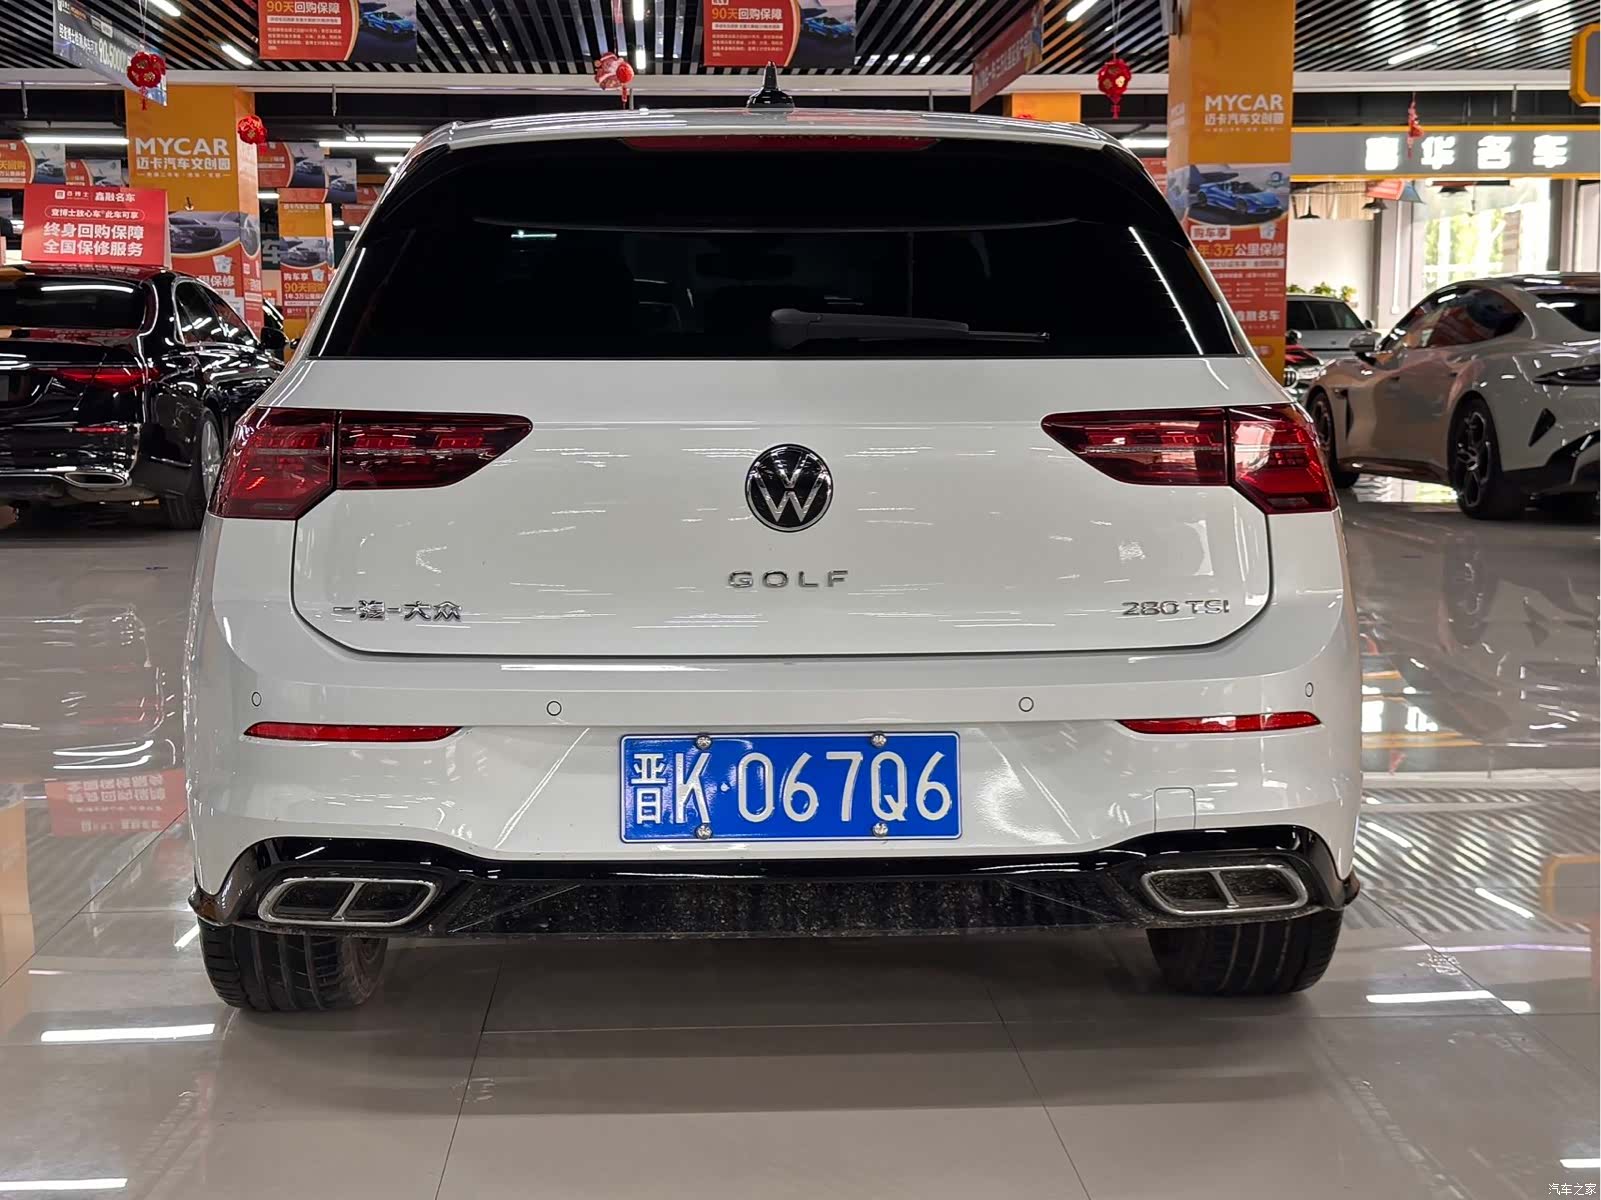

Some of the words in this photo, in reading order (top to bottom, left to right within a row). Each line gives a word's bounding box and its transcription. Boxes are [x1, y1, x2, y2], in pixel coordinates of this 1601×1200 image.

[1204, 95, 1284, 111] MYCAR
[135, 137, 230, 155] MYCAR
[43, 222, 145, 240] 终身回购保障
[43, 239, 144, 257] 全国保修服务
[728, 570, 849, 588] GOLF
[1121, 601, 1180, 616] 280
[1185, 599, 1230, 615] TSI
